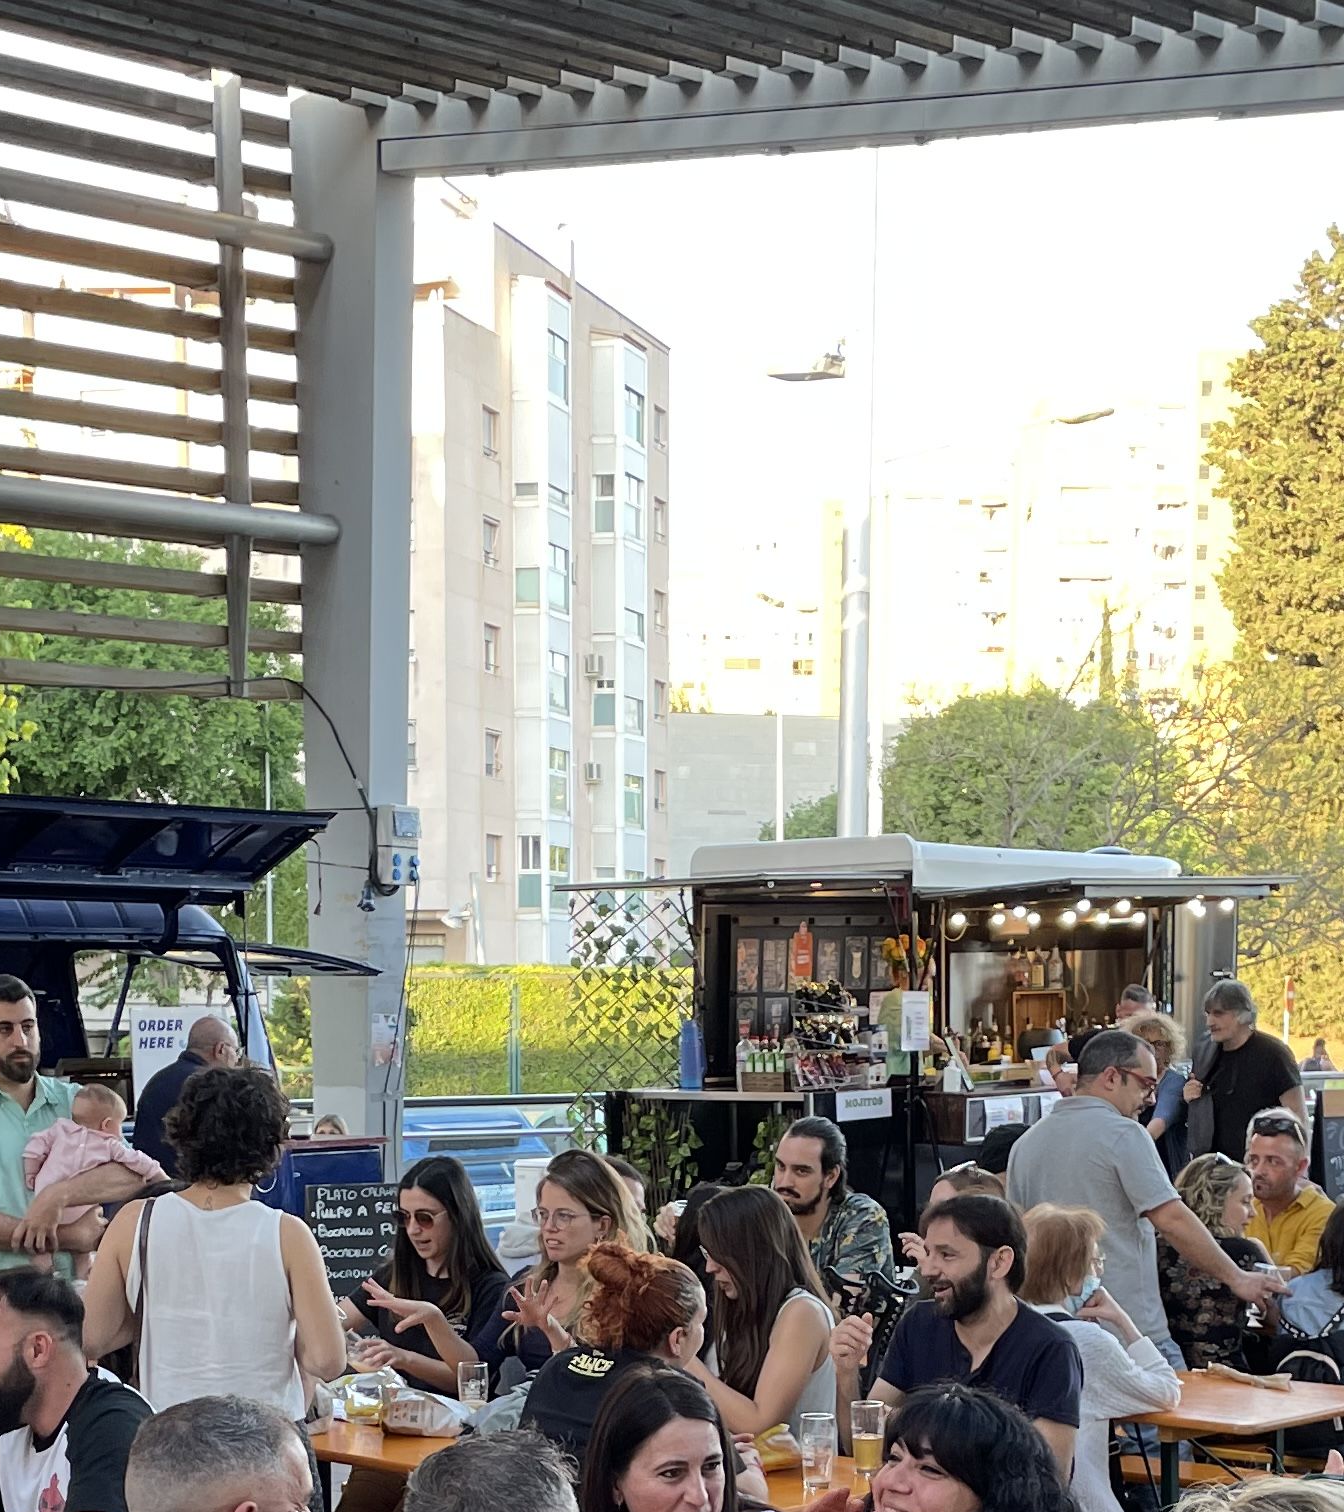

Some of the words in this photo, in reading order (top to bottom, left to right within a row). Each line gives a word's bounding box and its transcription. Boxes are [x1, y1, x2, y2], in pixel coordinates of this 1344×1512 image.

[138, 1019, 183, 1032] ORDER
[138, 1036, 175, 1049] HERE
[845, 1096, 883, 1109] MOJITOS
[316, 1187, 358, 1201] PLATO
[357, 1205, 369, 1217] A
